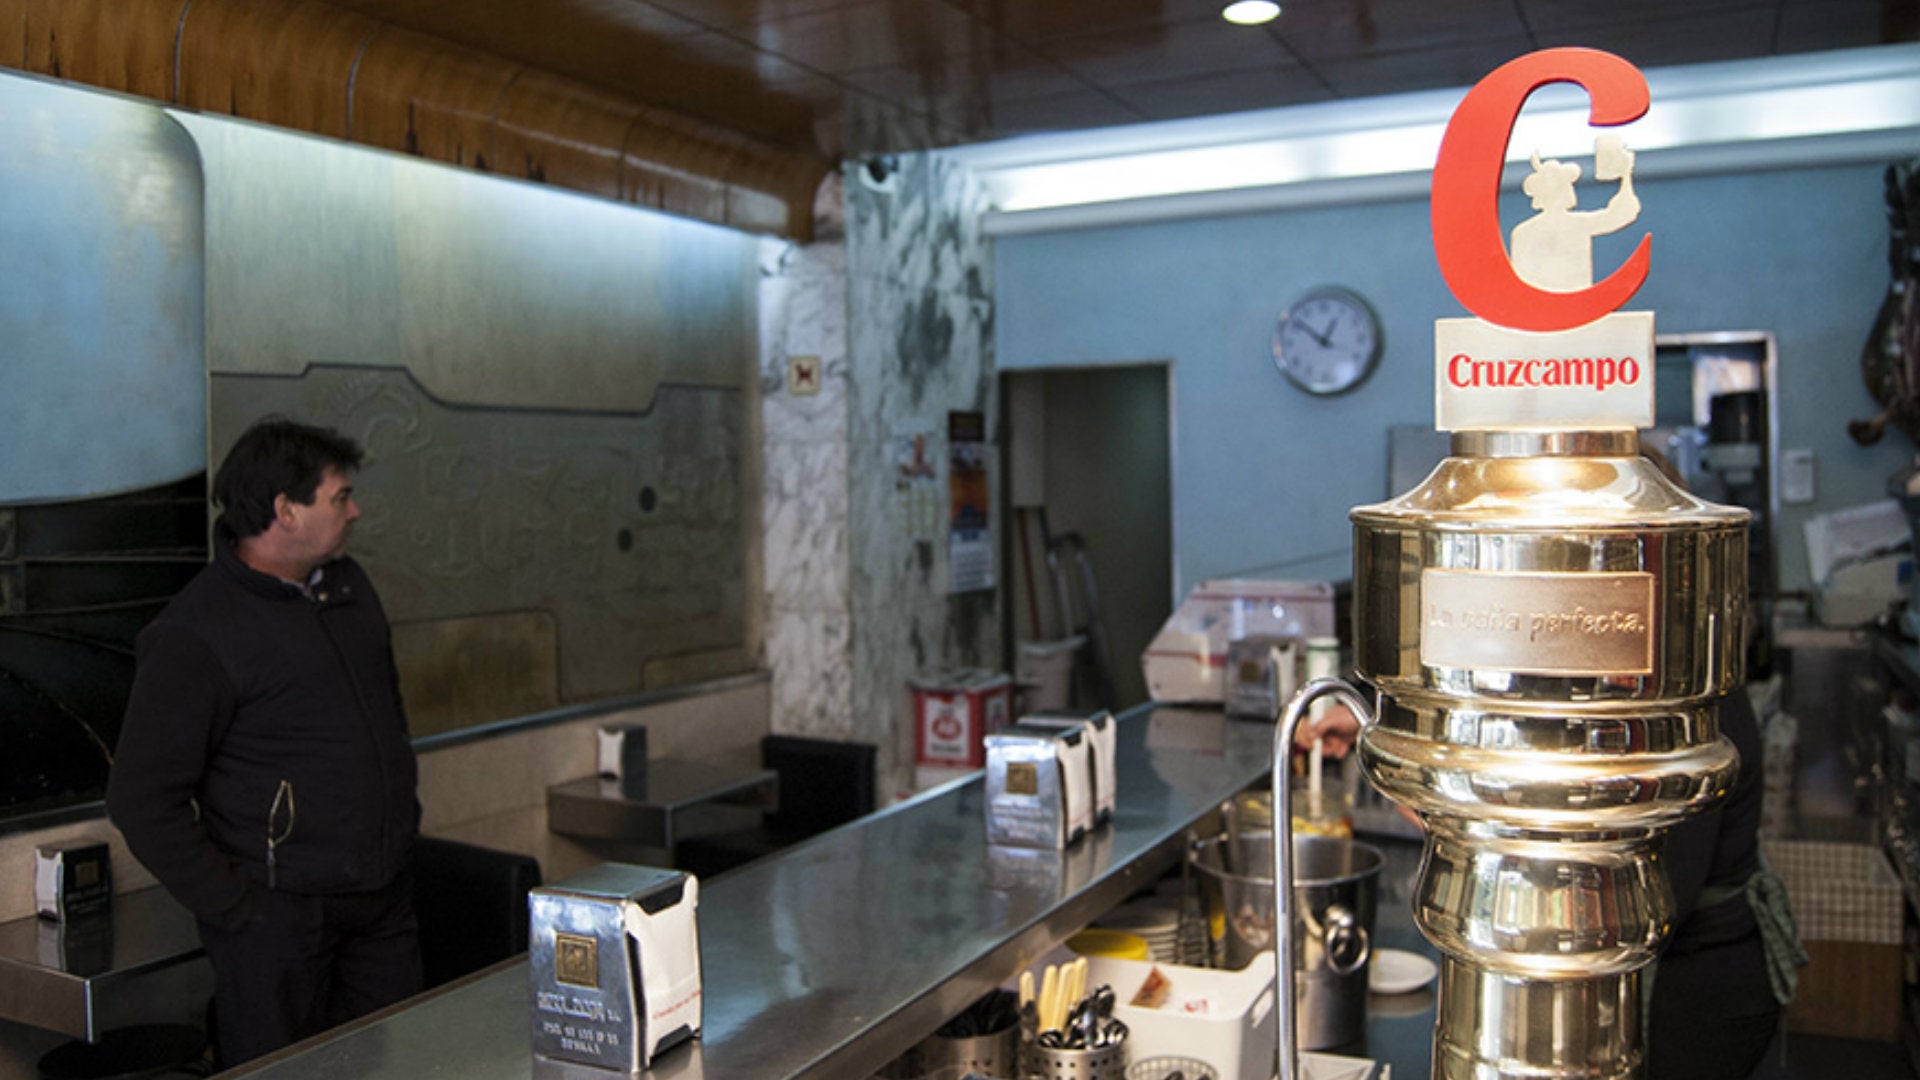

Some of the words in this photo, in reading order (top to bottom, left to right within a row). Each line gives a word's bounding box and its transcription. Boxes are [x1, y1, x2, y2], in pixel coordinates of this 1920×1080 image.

[1448, 353, 1640, 391] Cruzcampo
[1429, 602, 1453, 628] La
[1460, 602, 1521, 633] caña
[1529, 605, 1646, 643] perfecta.
